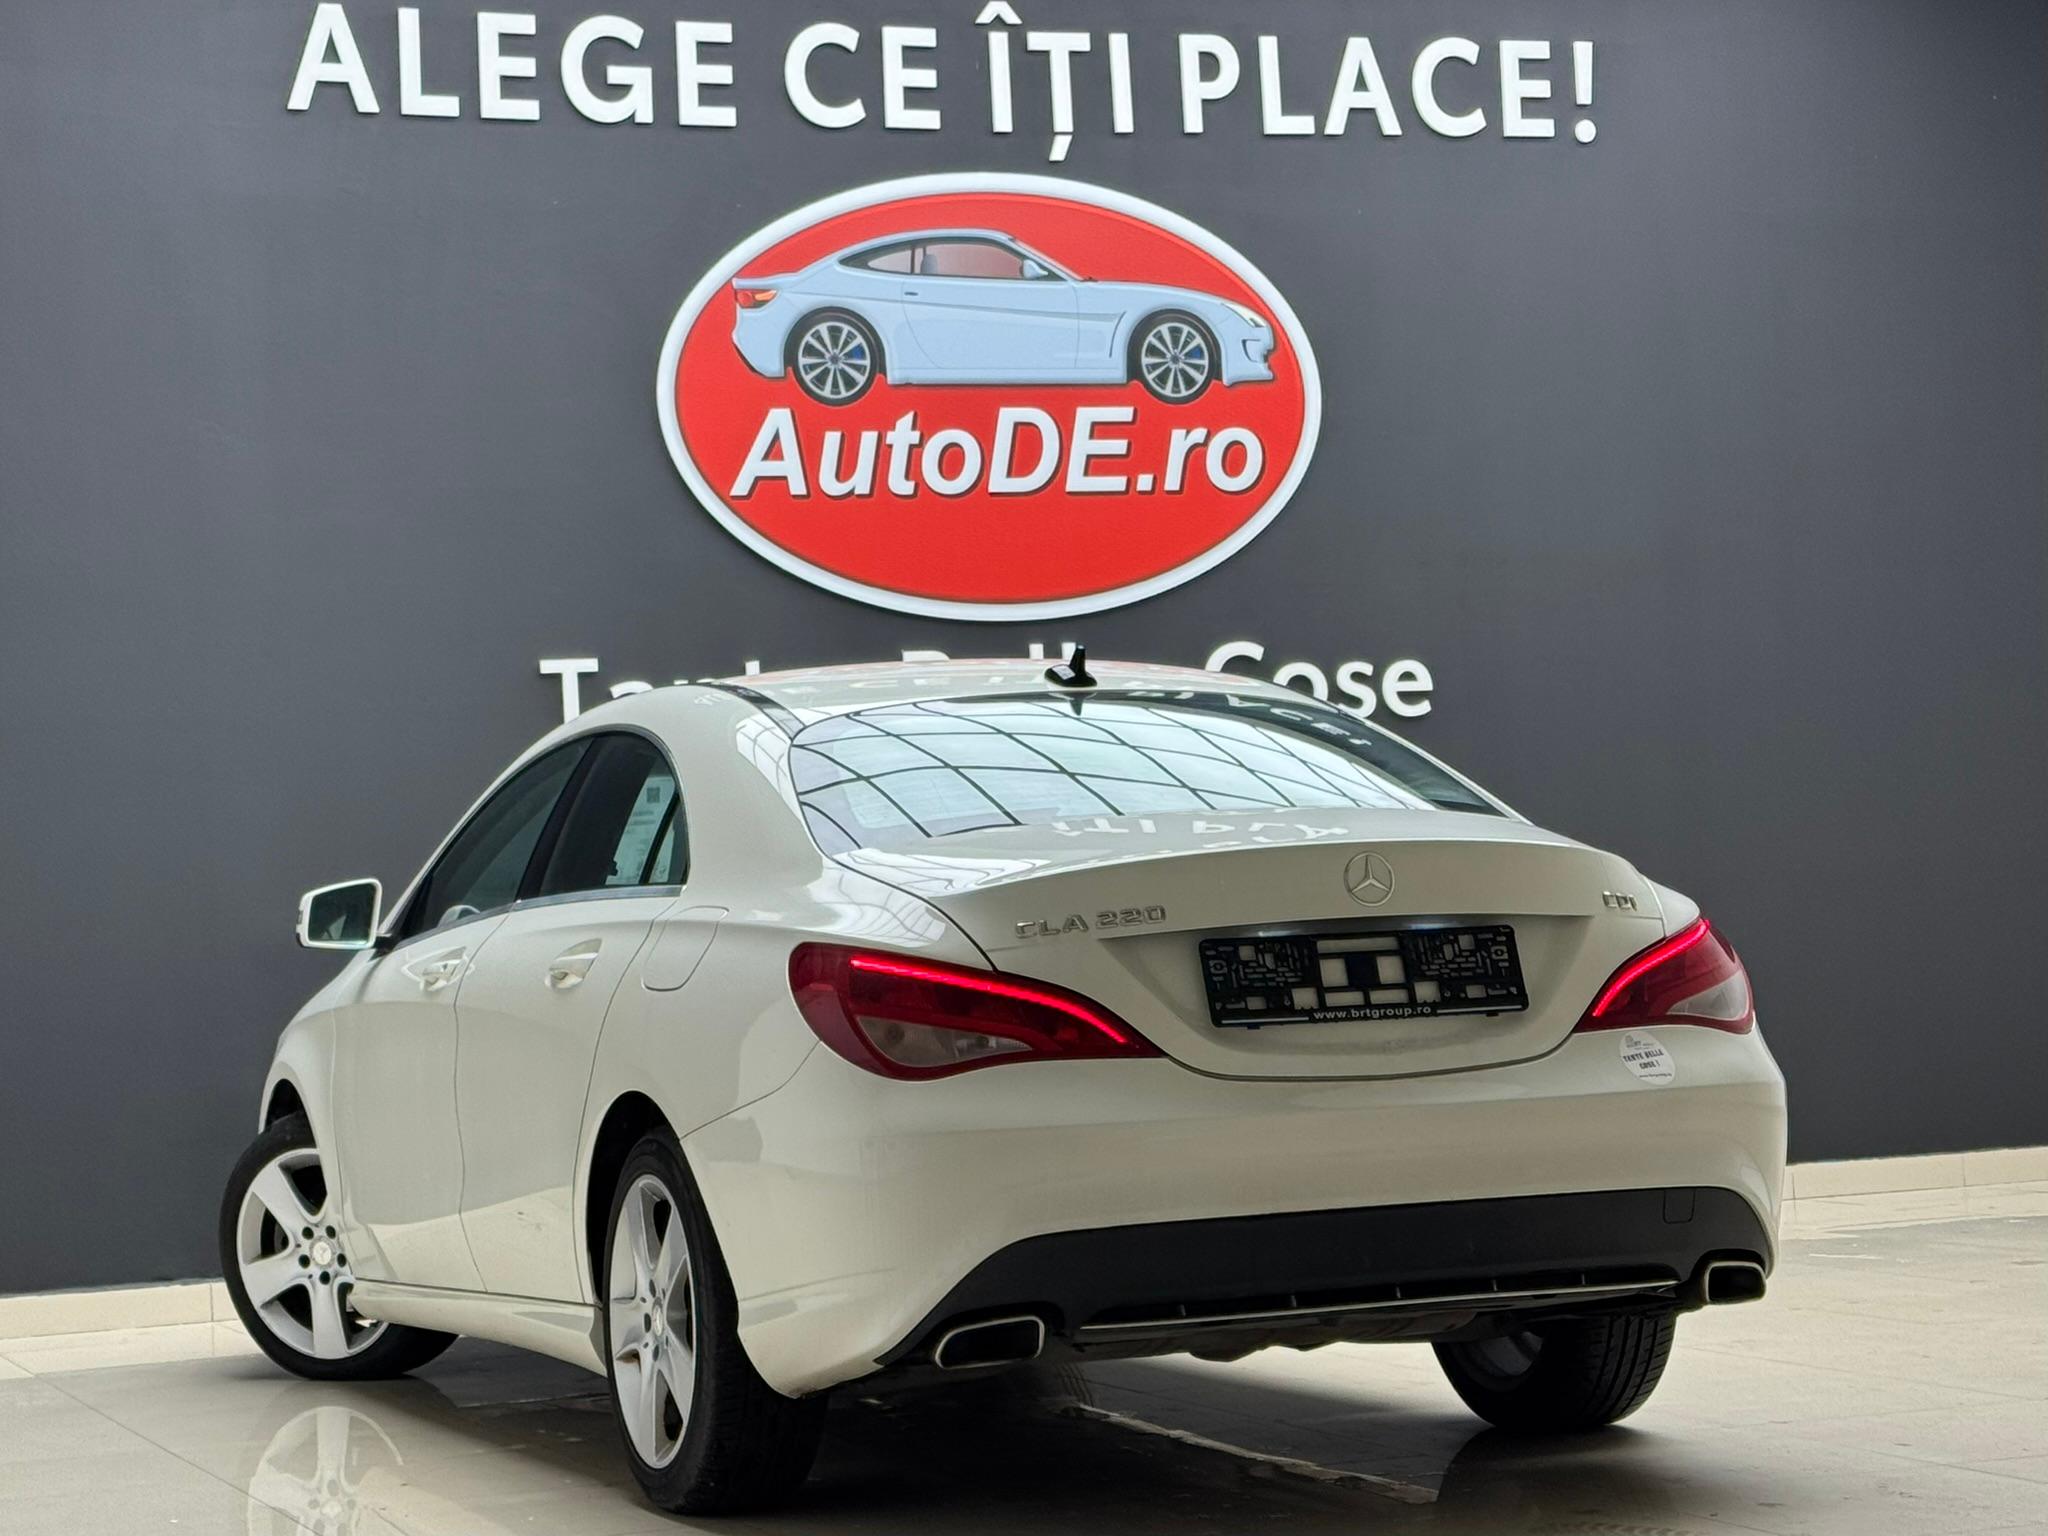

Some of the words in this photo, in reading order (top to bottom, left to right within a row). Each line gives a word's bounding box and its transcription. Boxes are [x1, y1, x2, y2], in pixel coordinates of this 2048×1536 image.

[287, 2, 737, 127] ALEGE
[784, 21, 942, 131] CE
[1178, 33, 1598, 145] PLACE!
[729, 406, 1265, 499] AutoDE.ro
[1015, 914, 1089, 939] CLA
[1096, 904, 1166, 930] 220
[1313, 1006, 1432, 1020] www.brtgroup.ro
